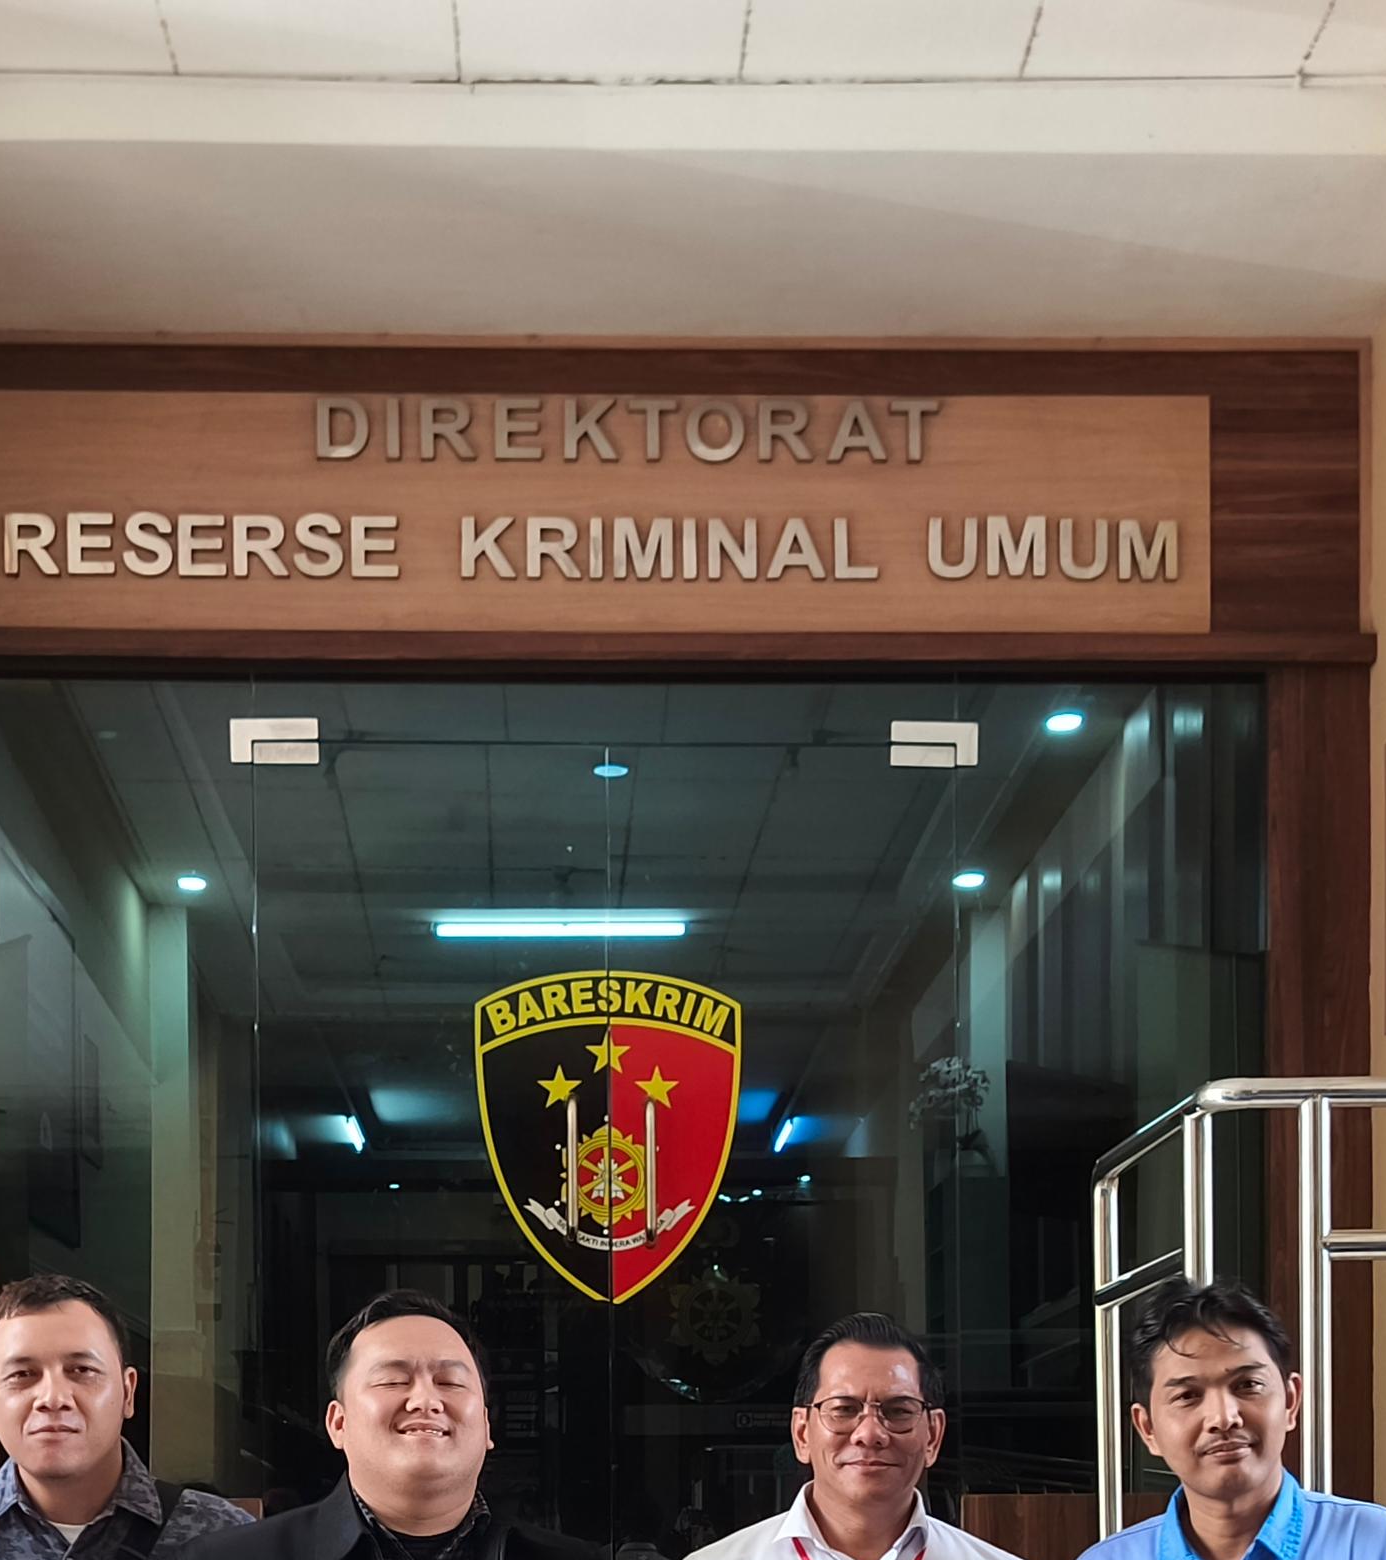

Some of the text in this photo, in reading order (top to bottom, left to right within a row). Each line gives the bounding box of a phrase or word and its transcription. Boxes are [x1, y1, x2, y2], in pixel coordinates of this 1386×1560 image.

[315, 397, 942, 463] DIREKTORAT
[4, 510, 1182, 582] RESERSE KRIMINAL UMUM
[485, 979, 731, 1037] BARESKRIM
